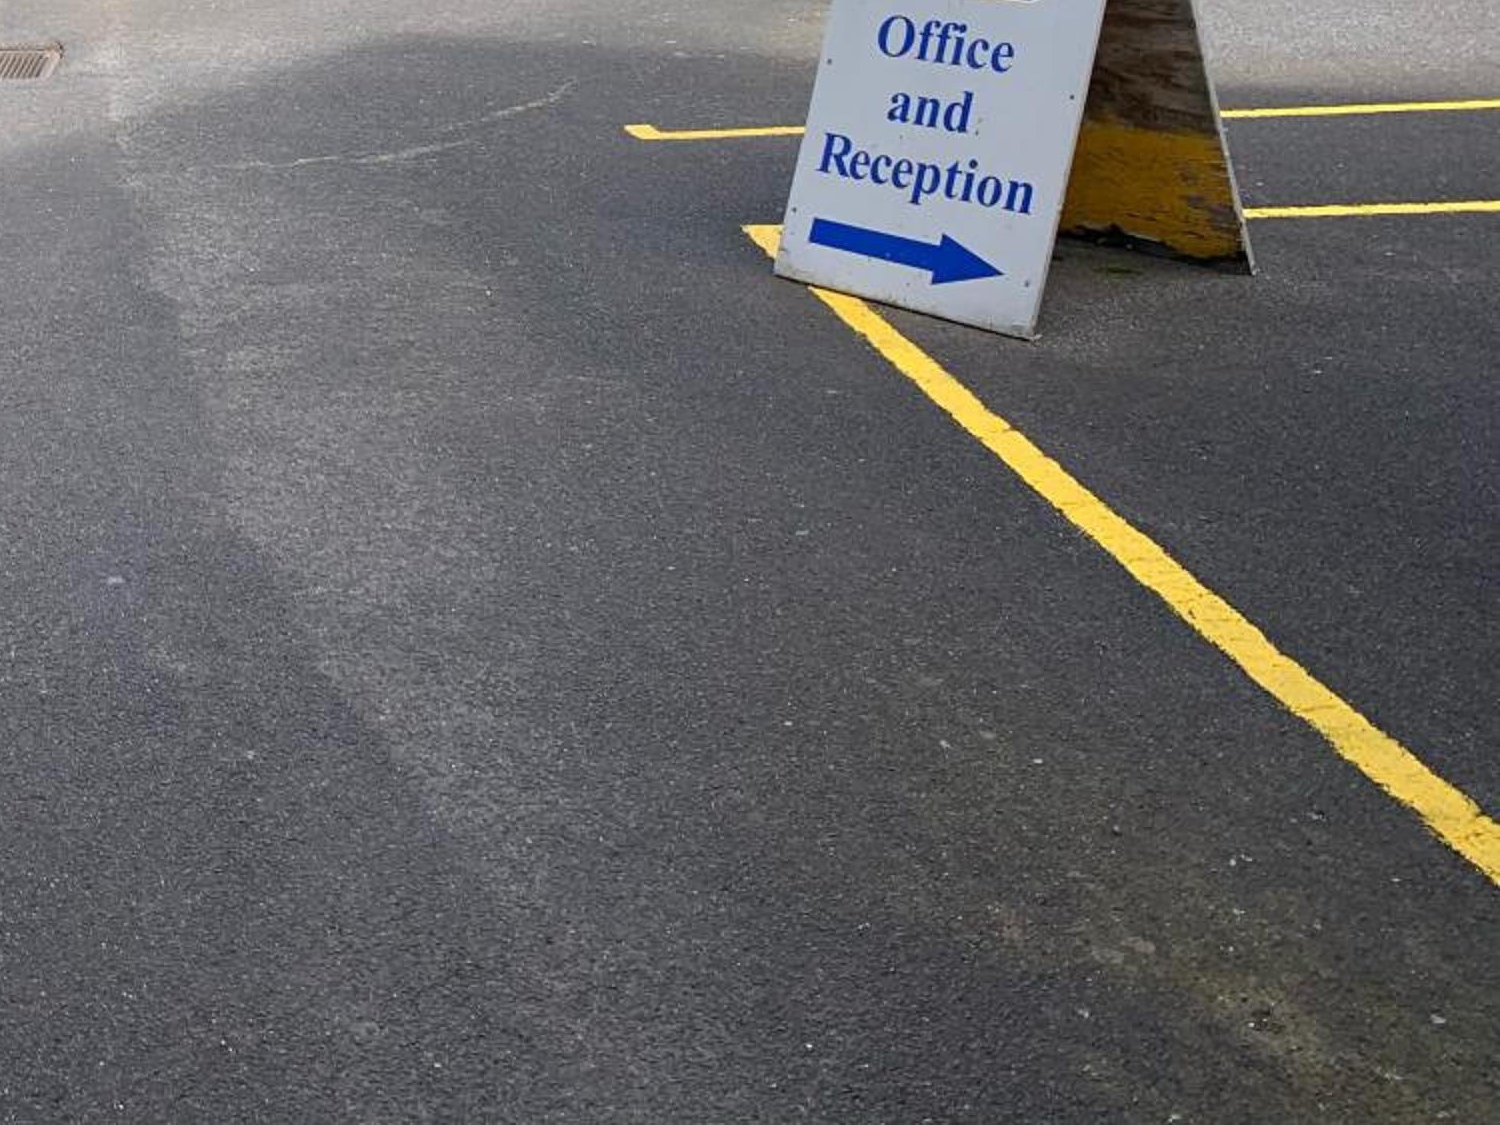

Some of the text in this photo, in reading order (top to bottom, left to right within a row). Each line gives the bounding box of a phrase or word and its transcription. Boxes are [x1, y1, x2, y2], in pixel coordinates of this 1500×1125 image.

[877, 14, 1015, 73] Office
[886, 90, 974, 134] and
[816, 132, 1034, 215] Reception
